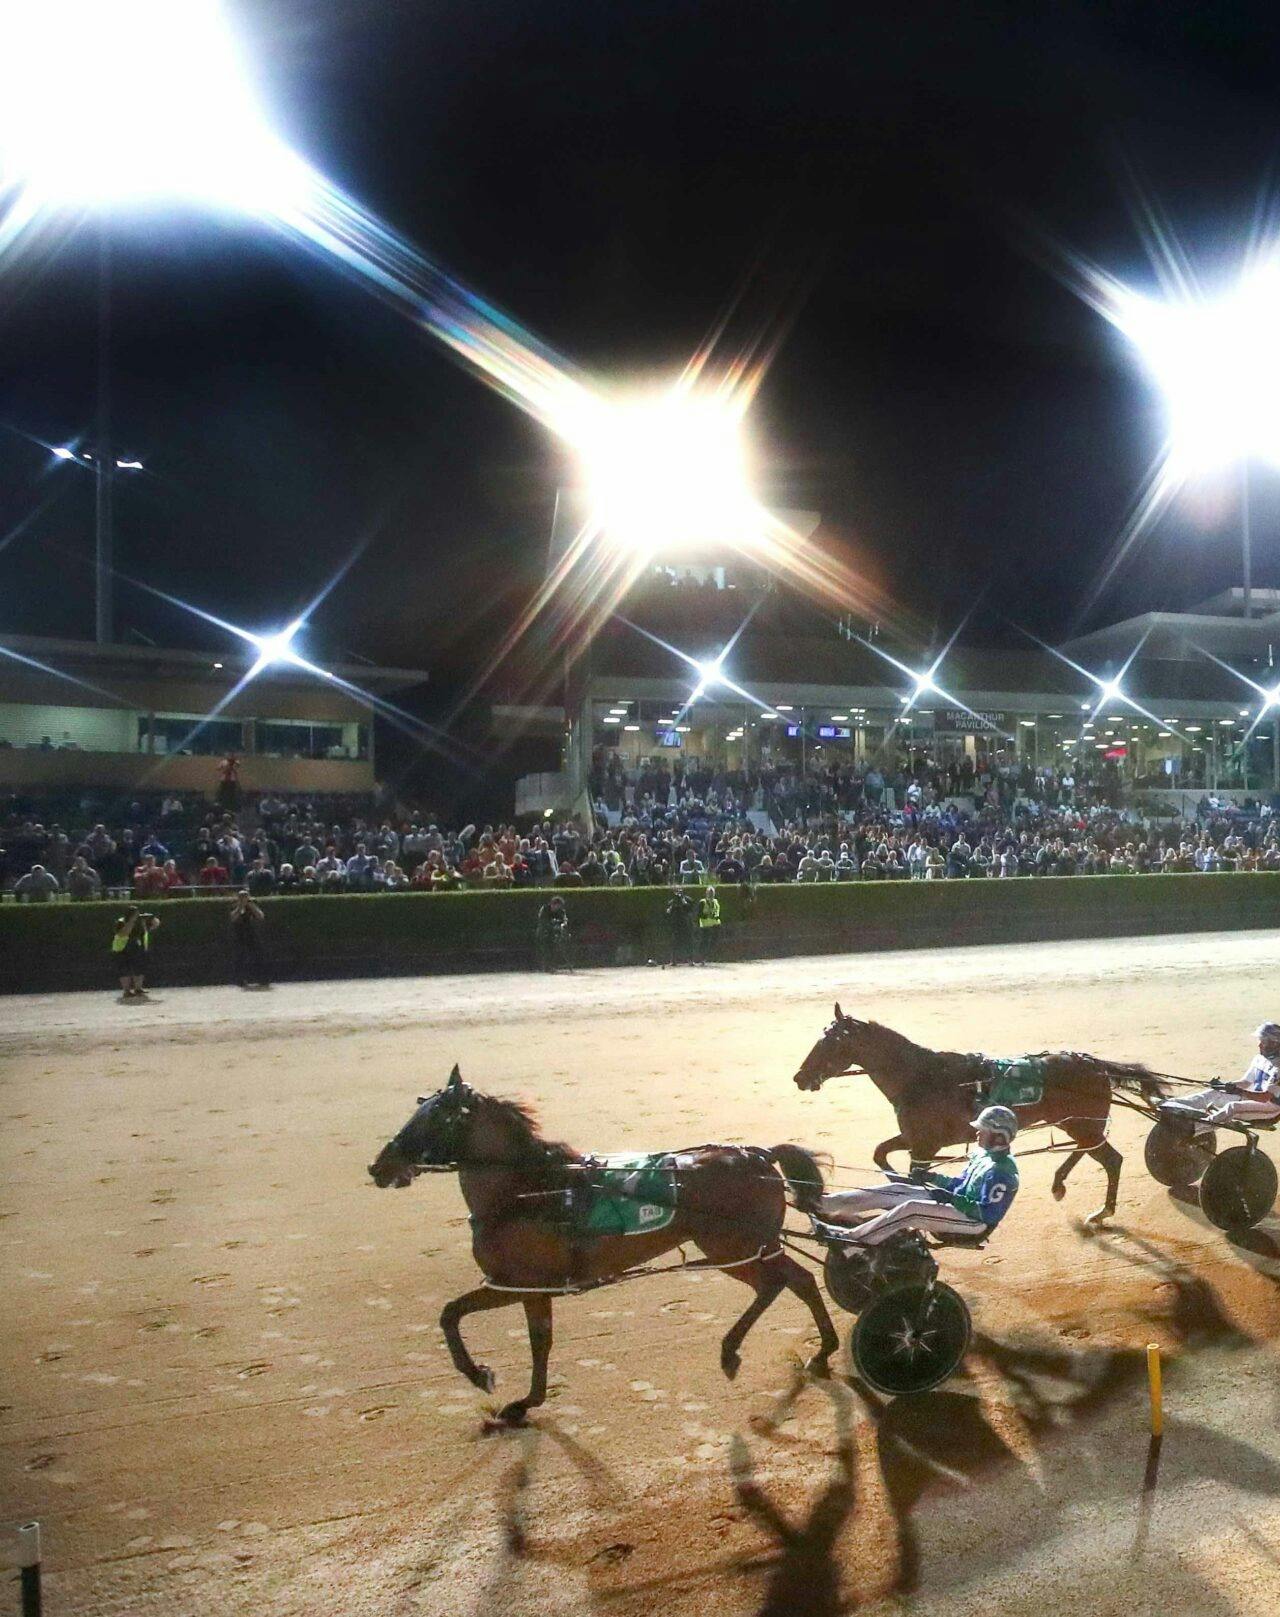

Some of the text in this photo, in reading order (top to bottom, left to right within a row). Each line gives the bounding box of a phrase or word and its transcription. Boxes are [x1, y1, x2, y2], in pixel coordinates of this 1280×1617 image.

[946, 712, 1004, 720] MACARTHUR
[955, 721, 997, 729] PAVILION
[989, 1183, 1007, 1203] G
